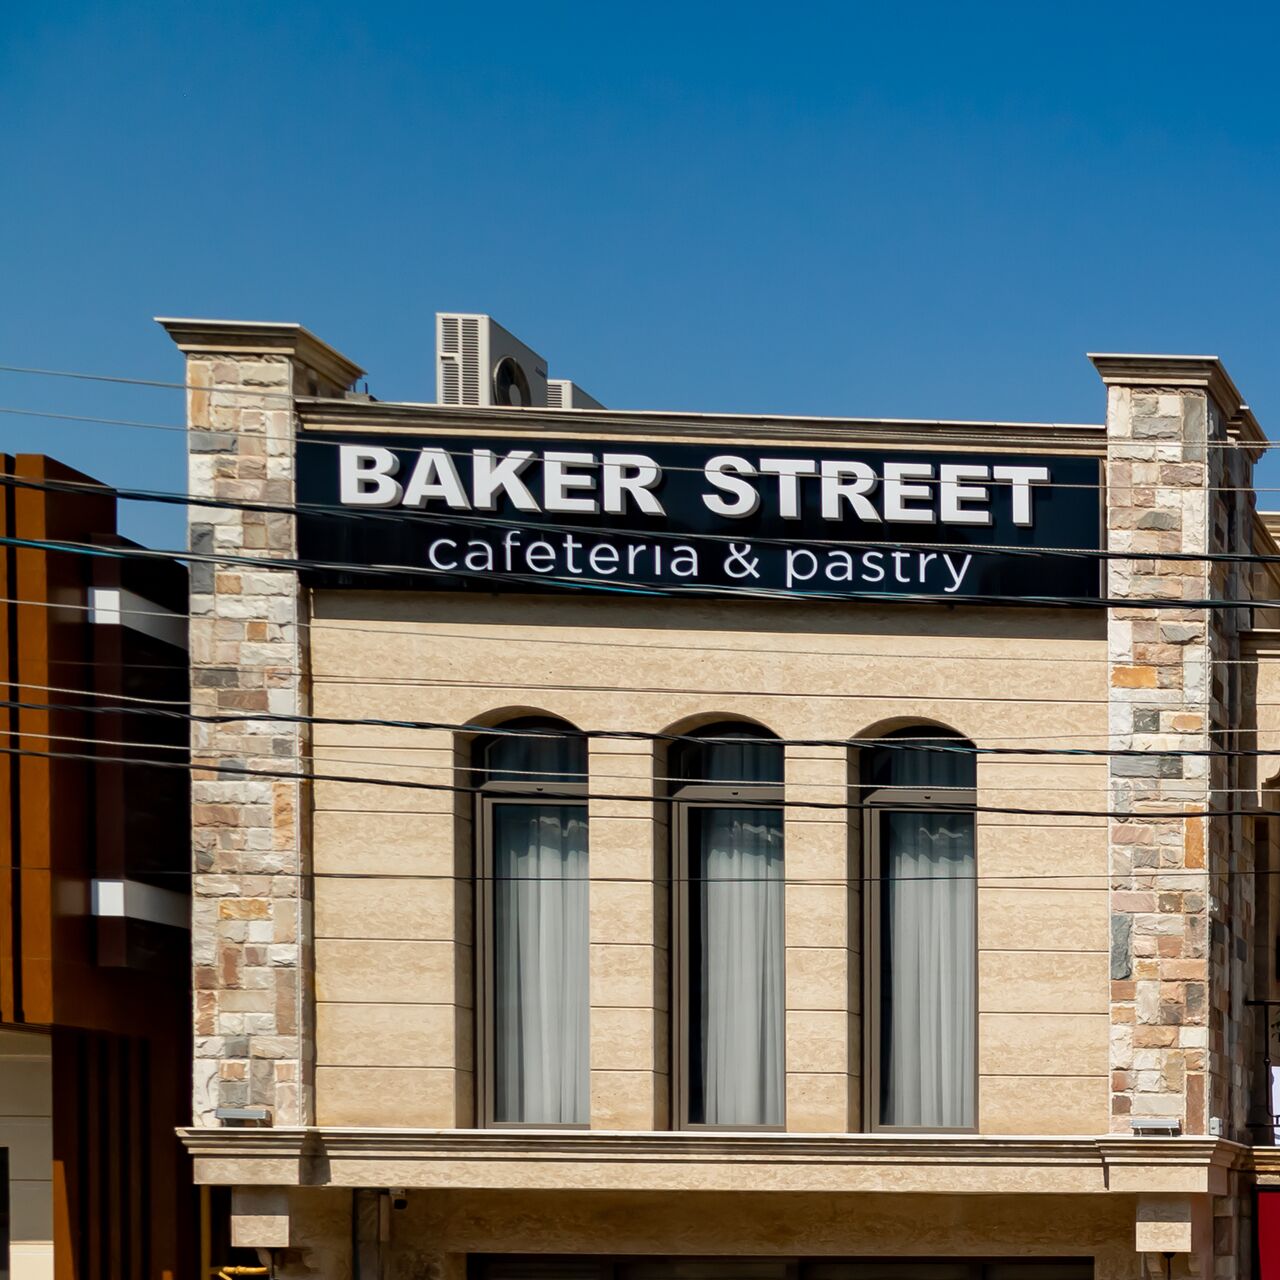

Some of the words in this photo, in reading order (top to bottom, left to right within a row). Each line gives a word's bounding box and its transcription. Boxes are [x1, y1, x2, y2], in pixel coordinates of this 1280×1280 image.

[339, 445, 667, 517] BAKER
[701, 455, 1051, 527] STREET
[428, 530, 700, 577] cafeteria
[723, 543, 761, 579] &
[786, 549, 973, 593] pastry
